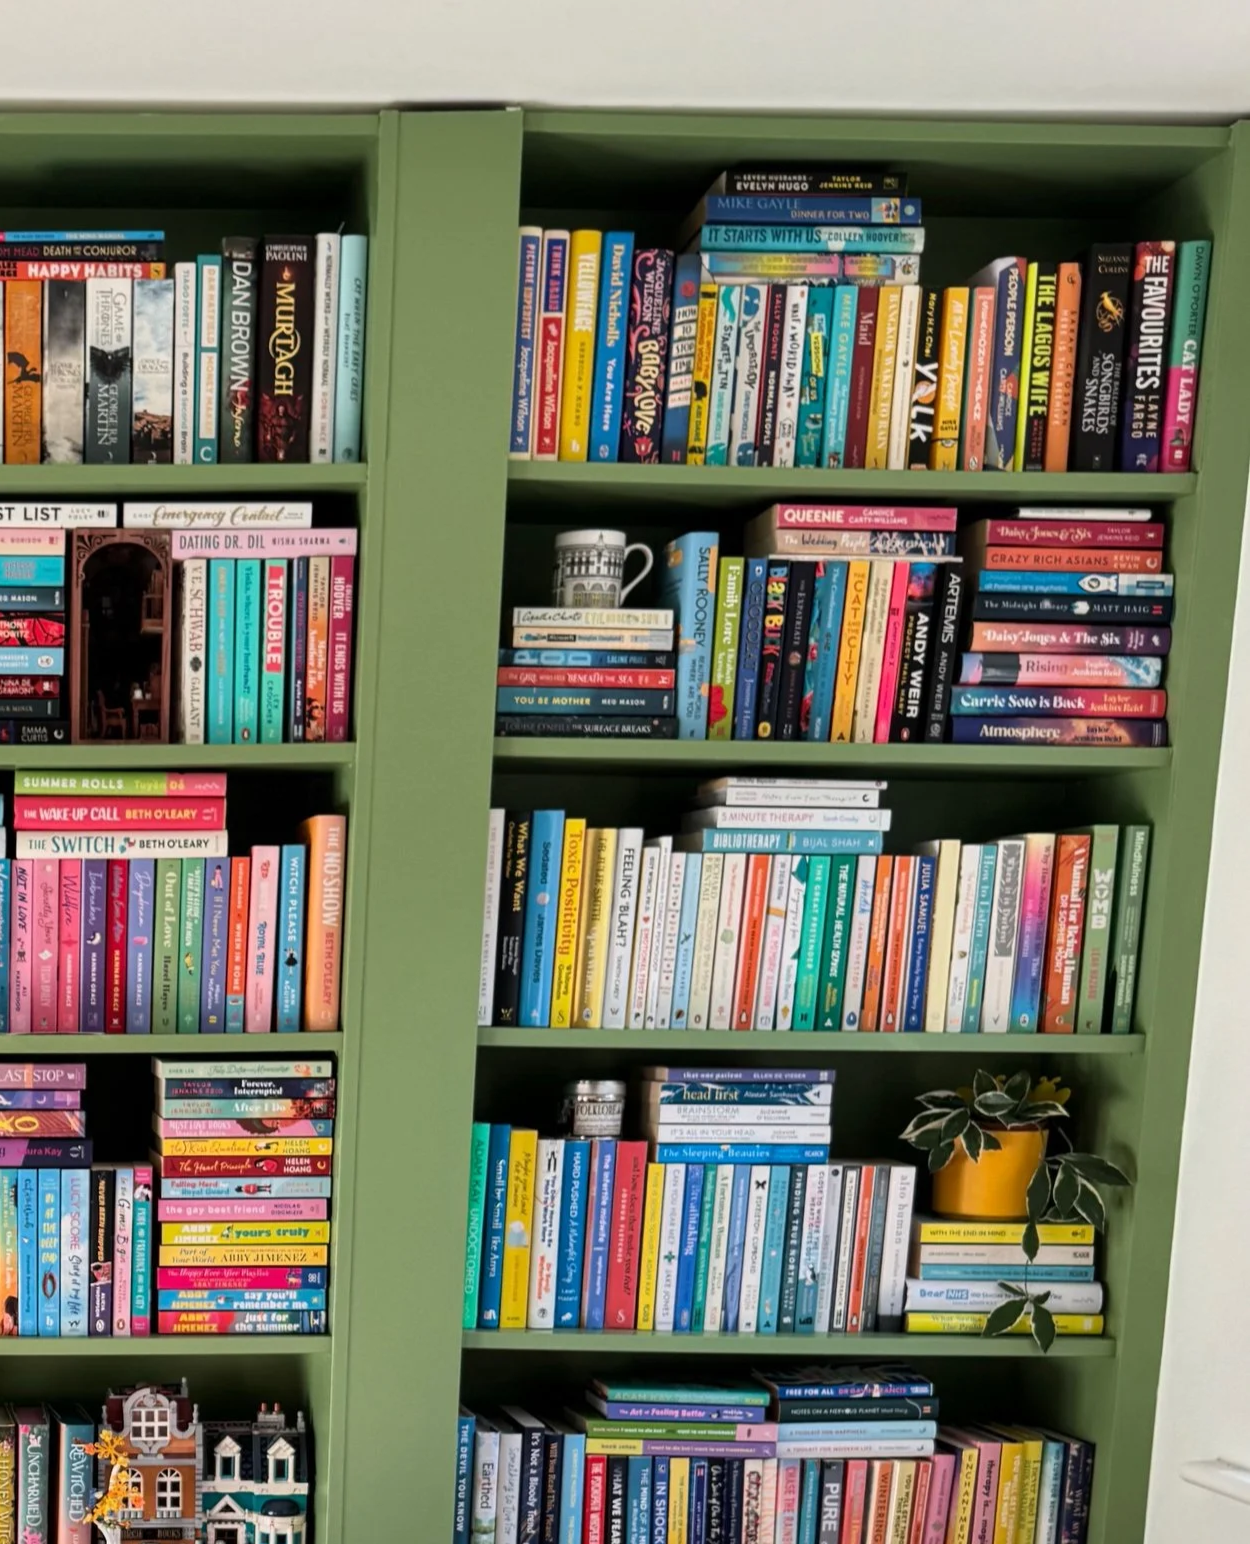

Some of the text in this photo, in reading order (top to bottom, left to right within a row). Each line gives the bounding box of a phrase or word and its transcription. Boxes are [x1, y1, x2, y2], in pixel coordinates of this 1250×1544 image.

[736, 182, 809, 192] EVELYN HUGO
[708, 229, 821, 242] IT STARTS WITH US
[27, 264, 142, 278] HAPPY HABITS
[611, 244, 624, 287] David
[230, 262, 252, 391] DAN BROWN
[1136, 256, 1169, 390] THE FAVOURITES
[1030, 274, 1057, 416] THE LAGOS WIFE
[1176, 339, 1198, 423] CAT LADY
[24, 507, 61, 520] LIST
[784, 510, 844, 522] QUEENIE
[179, 536, 220, 549] DATING
[247, 536, 265, 548] DIL
[991, 555, 1108, 565] CRAZY RICH ASIANS
[942, 572, 961, 643] ARTEMIS
[267, 577, 283, 664] TROUBLE
[986, 631, 1019, 644] Daisy
[1060, 633, 1068, 643] &
[1074, 633, 1097, 643] The
[1101, 633, 1120, 645] Six
[906, 612, 929, 718] ANDY WEIR
[961, 695, 1085, 709] Carrie Soto is Back
[980, 726, 1061, 739] Atmosphere
[24, 777, 124, 789] SUMMER ROLLS
[24, 808, 120, 820] THE WAKE-UP CALL
[328, 827, 340, 845] THE
[713, 834, 780, 849] BIBLIOTHERAPY
[29, 836, 115, 853] THE SWITCH
[139, 839, 209, 849] BETH O'LEARY
[33, 1072, 64, 1082] STOP
[235, 1228, 310, 1238] yours truly
[221, 1252, 306, 1262] ABBY JIMENEZ
[465, 1209, 479, 1294] UNDOCTORED
[26, 1444, 41, 1527] UNCHARMED
[480, 1463, 493, 1509] Earthed
[655, 1481, 666, 1495] IN
[822, 1482, 841, 1532] PURE
